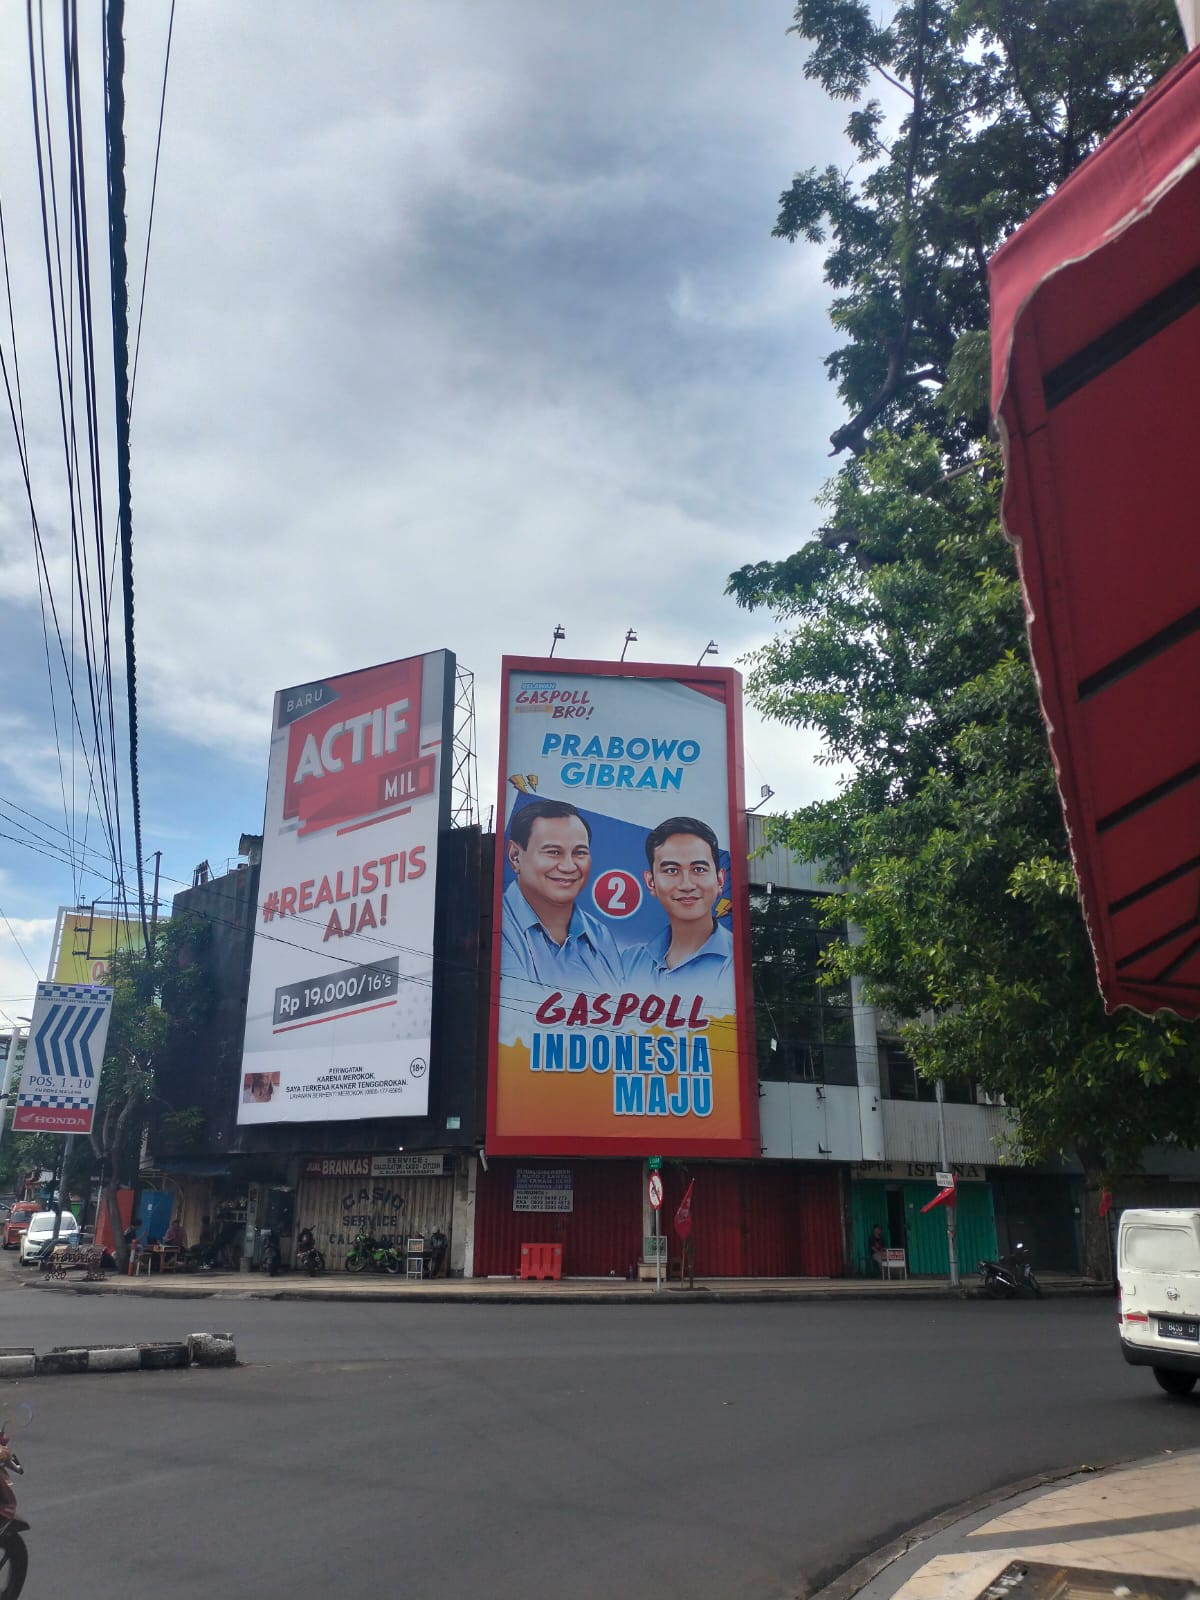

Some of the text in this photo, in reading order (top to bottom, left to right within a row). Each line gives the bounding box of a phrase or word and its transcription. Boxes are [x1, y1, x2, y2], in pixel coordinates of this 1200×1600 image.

[286, 688, 323, 713] BARU
[516, 690, 590, 704] GASPOLL
[552, 706, 594, 719] BRO!
[293, 698, 412, 784] ACTIF
[541, 733, 701, 763] PRABOWO
[385, 771, 416, 800] MIL
[560, 762, 684, 790] GIBRAN
[263, 845, 427, 923] #REALISTIS
[607, 877, 626, 909] 2
[323, 893, 388, 942] AJA!
[279, 973, 392, 1015] Rp 19.000/16's
[536, 992, 710, 1028] GASPOLL
[530, 1033, 712, 1074] INDONESIA
[317, 1074, 342, 1083] KARENA
[411, 1063, 425, 1073] 18+
[286, 1085, 301, 1093] SAYA
[302, 1083, 330, 1092] TERKENA
[331, 1081, 356, 1090] KANKER
[614, 1075, 712, 1116] MAJU
[35, 1115, 87, 1127] HONDA
[322, 1159, 369, 1175] BRANKAS
[907, 1163, 980, 1178] ISTNA
[342, 1215, 397, 1227] SERVICE
